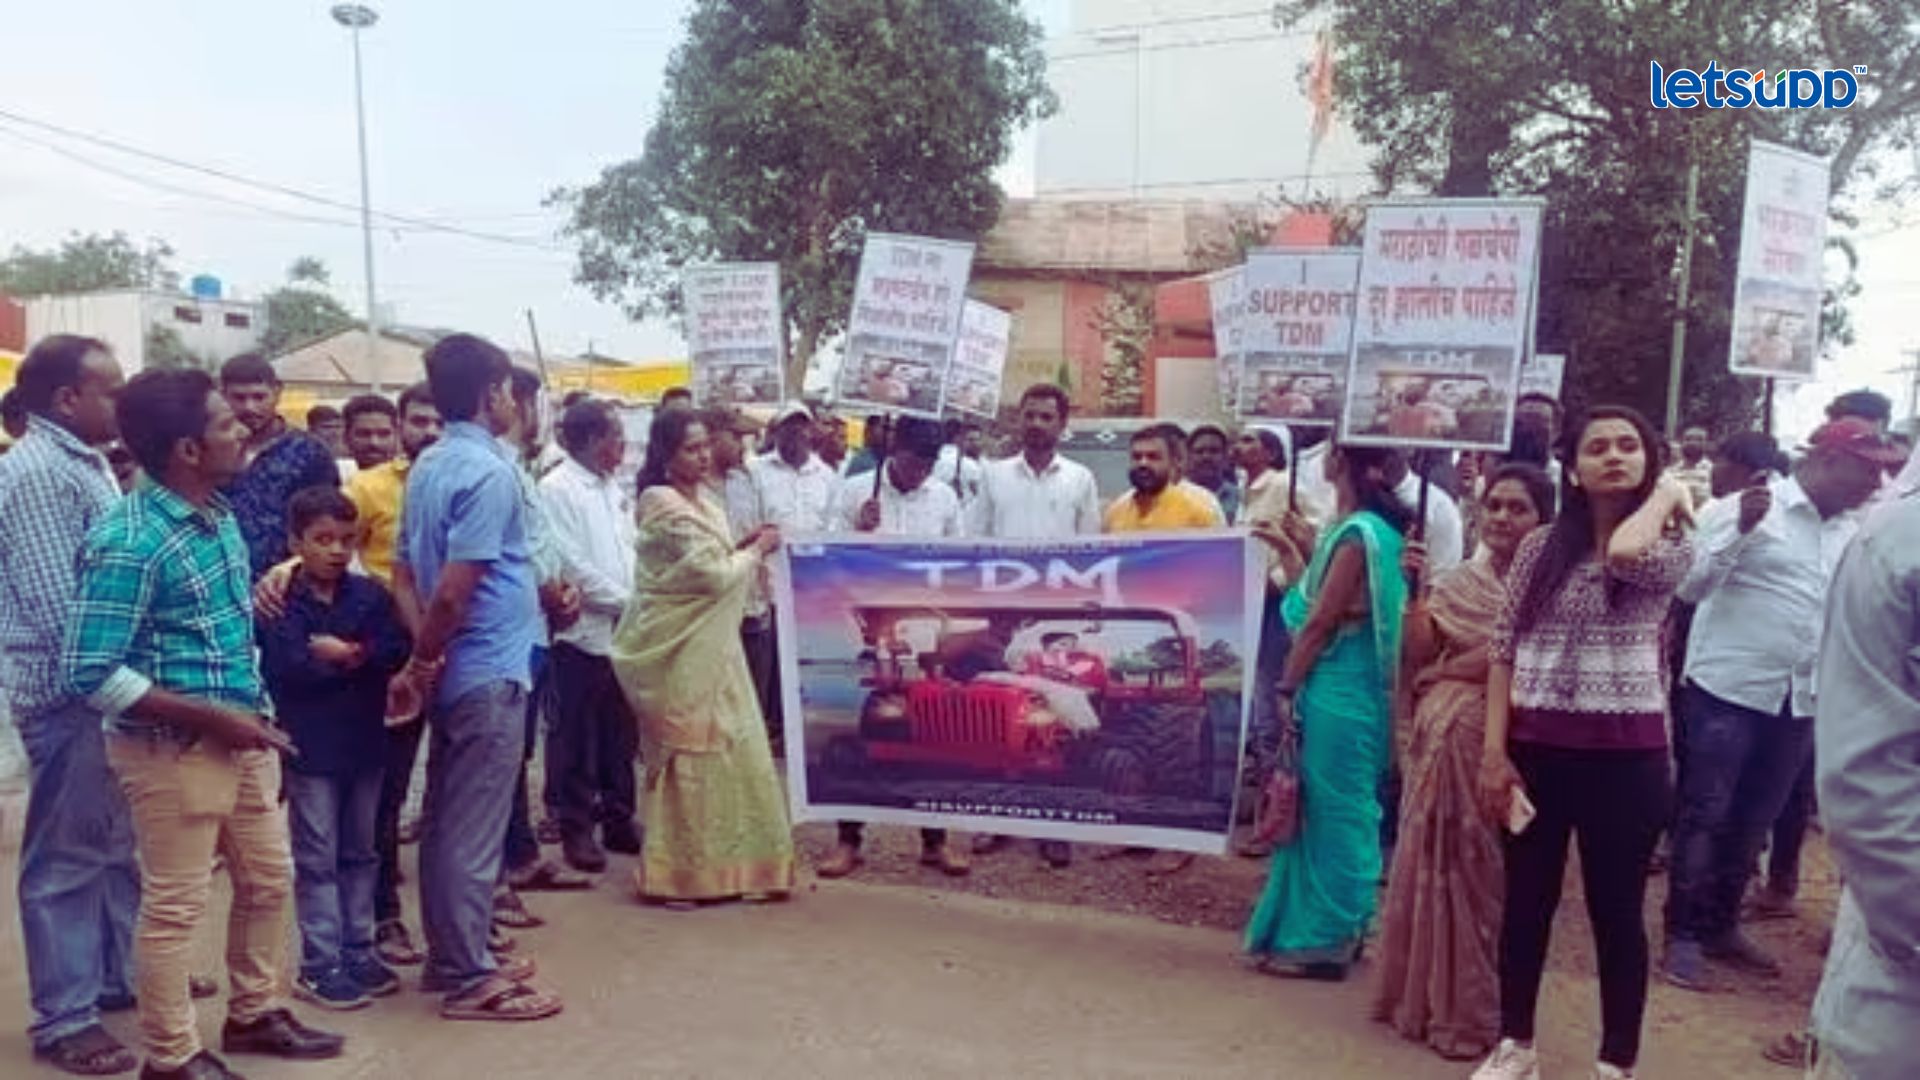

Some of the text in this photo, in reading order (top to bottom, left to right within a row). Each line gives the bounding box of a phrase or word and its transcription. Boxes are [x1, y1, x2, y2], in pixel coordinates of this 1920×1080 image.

[1248, 289, 1358, 317] SUPPORT
[1274, 322, 1325, 346] TDM
[902, 556, 1125, 606] TDM
